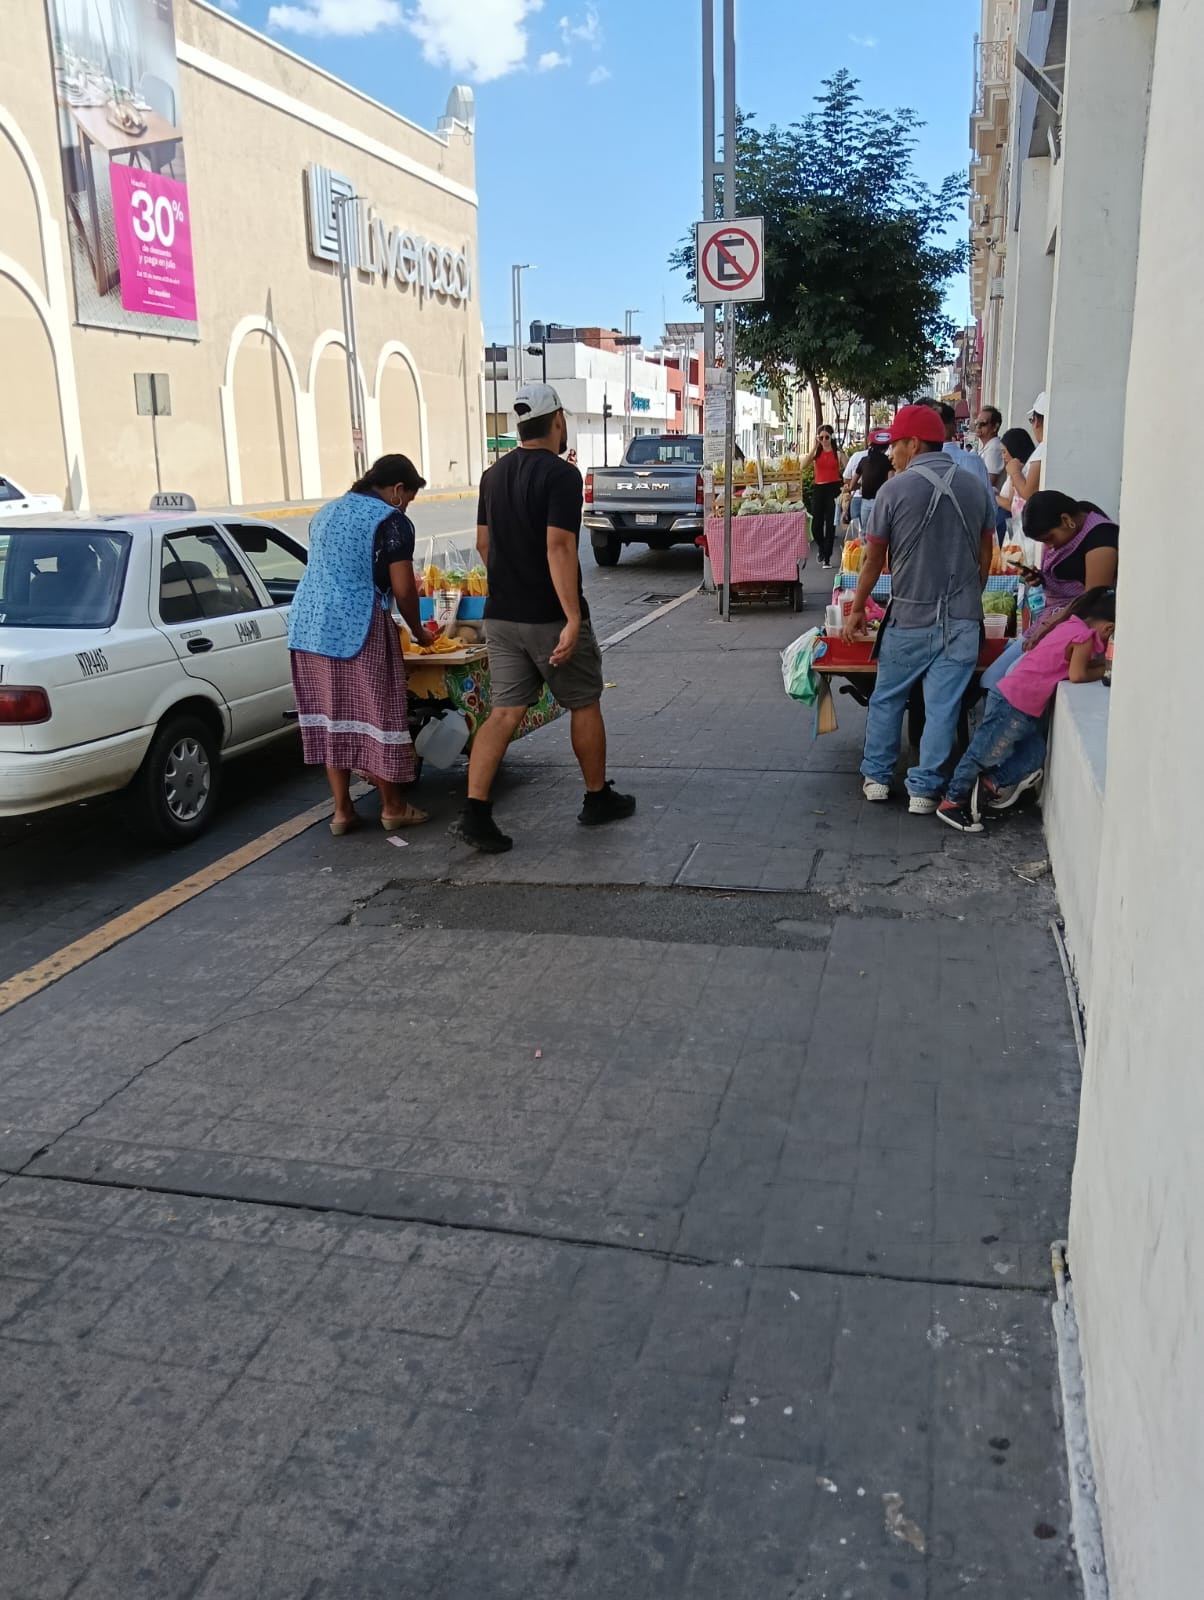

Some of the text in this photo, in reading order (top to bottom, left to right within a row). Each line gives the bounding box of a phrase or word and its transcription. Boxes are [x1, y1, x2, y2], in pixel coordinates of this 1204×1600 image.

[357, 198, 472, 302] Liverpool
[717, 238, 745, 282] E
[155, 495, 183, 506] TAXI
[616, 483, 669, 491] RAM
